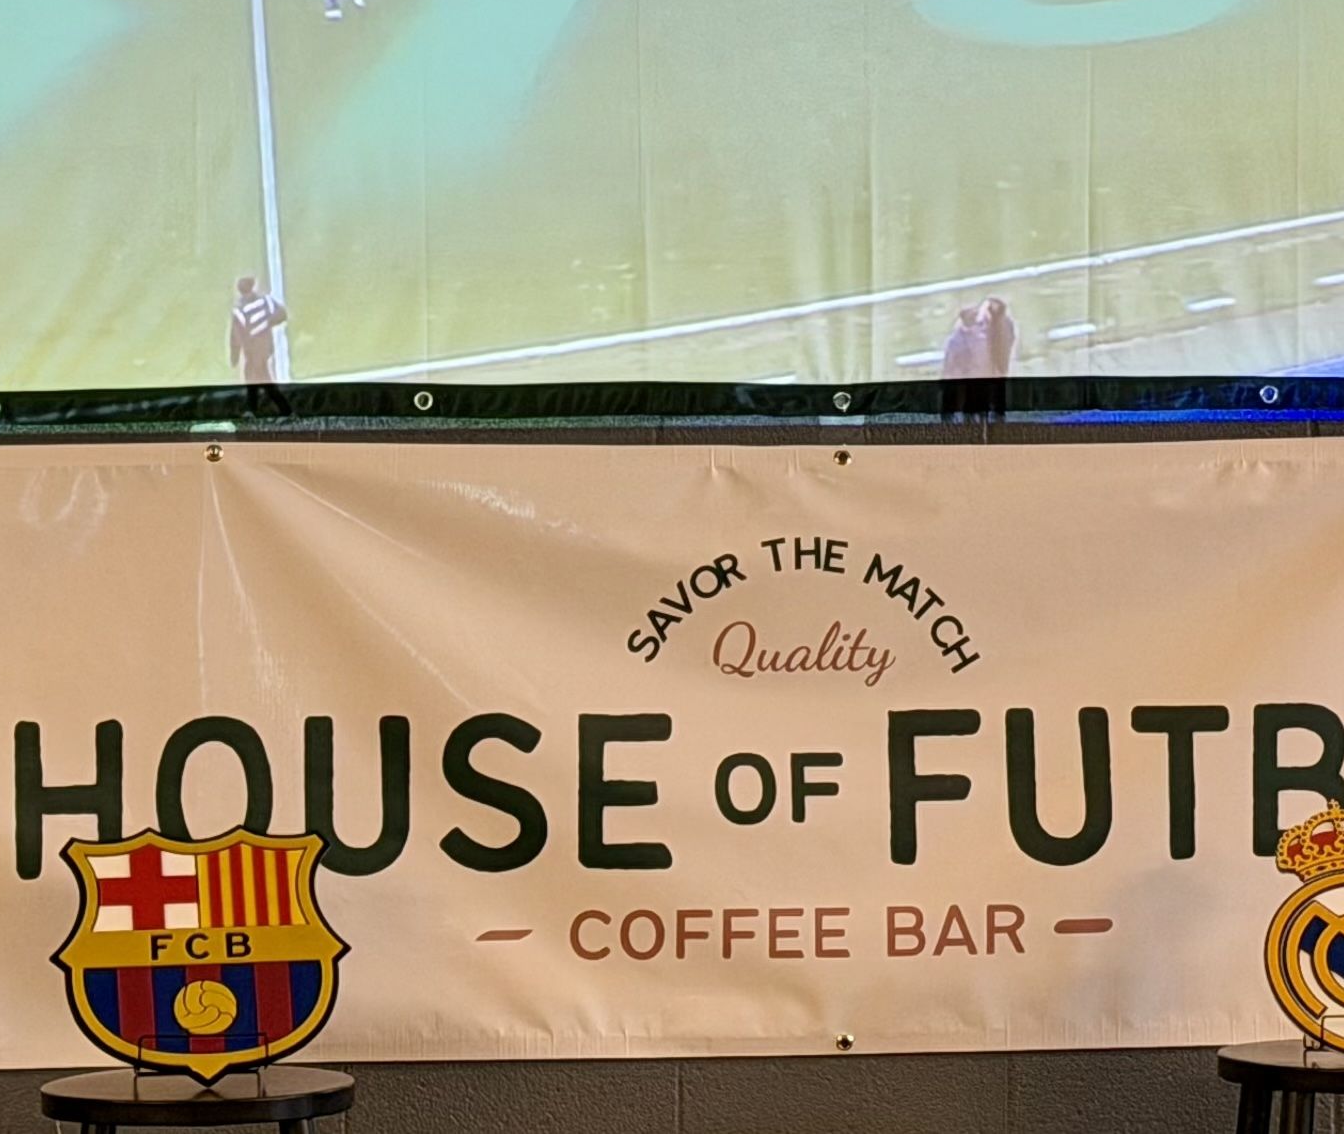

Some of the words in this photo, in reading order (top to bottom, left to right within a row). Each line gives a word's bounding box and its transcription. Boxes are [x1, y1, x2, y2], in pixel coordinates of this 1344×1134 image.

[627, 553, 747, 663] SAVOR
[761, 537, 849, 574] THE
[863, 553, 981, 674] MATCH
[712, 620, 896, 687] Quality
[13, 713, 673, 880] HOUSE
[714, 751, 844, 826] OF
[569, 908, 852, 961] COFFEE
[886, 904, 1027, 957] BAR
